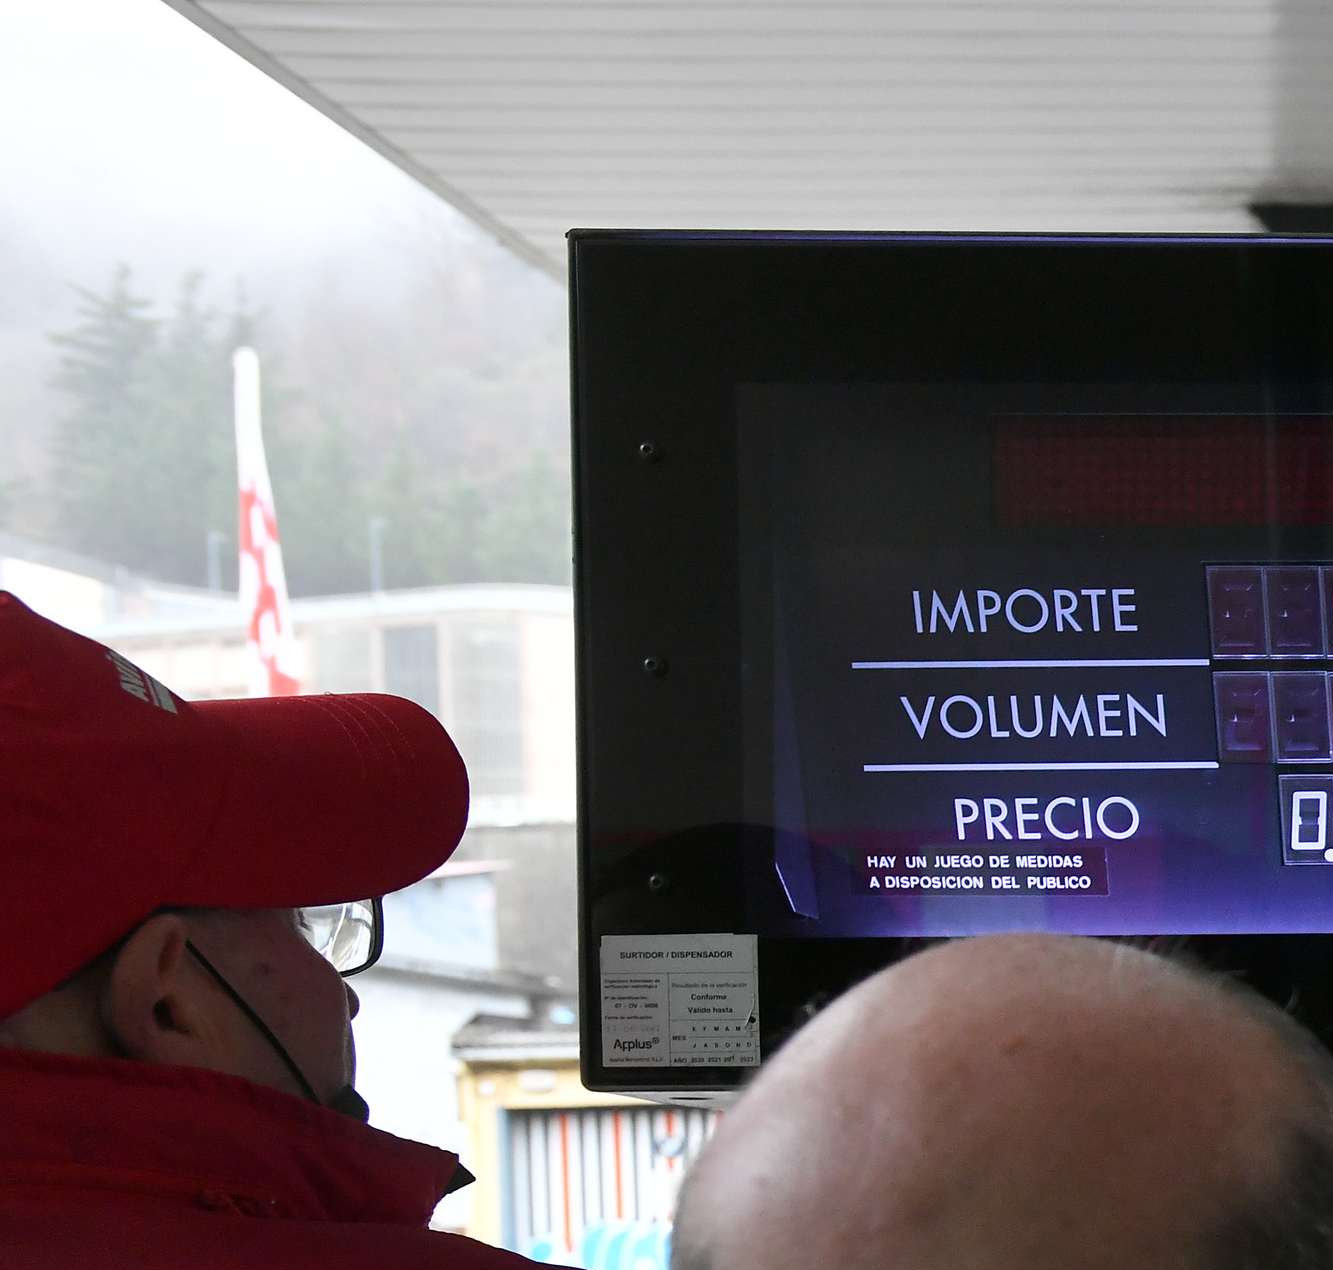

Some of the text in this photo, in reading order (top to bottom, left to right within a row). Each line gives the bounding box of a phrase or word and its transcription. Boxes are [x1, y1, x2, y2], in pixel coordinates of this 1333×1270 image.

[911, 588, 1140, 635] IMPORTE
[900, 692, 1168, 740] VOLUMEN
[953, 795, 1142, 842] PRECIO
[866, 853, 1084, 870] HAY UN JUEGO DE MEDIDAS
[869, 873, 1093, 891] A DISPOSICION DEL PUBLICO
[619, 951, 665, 960] SURTIDOR
[671, 951, 734, 960] DISPENSADOR
